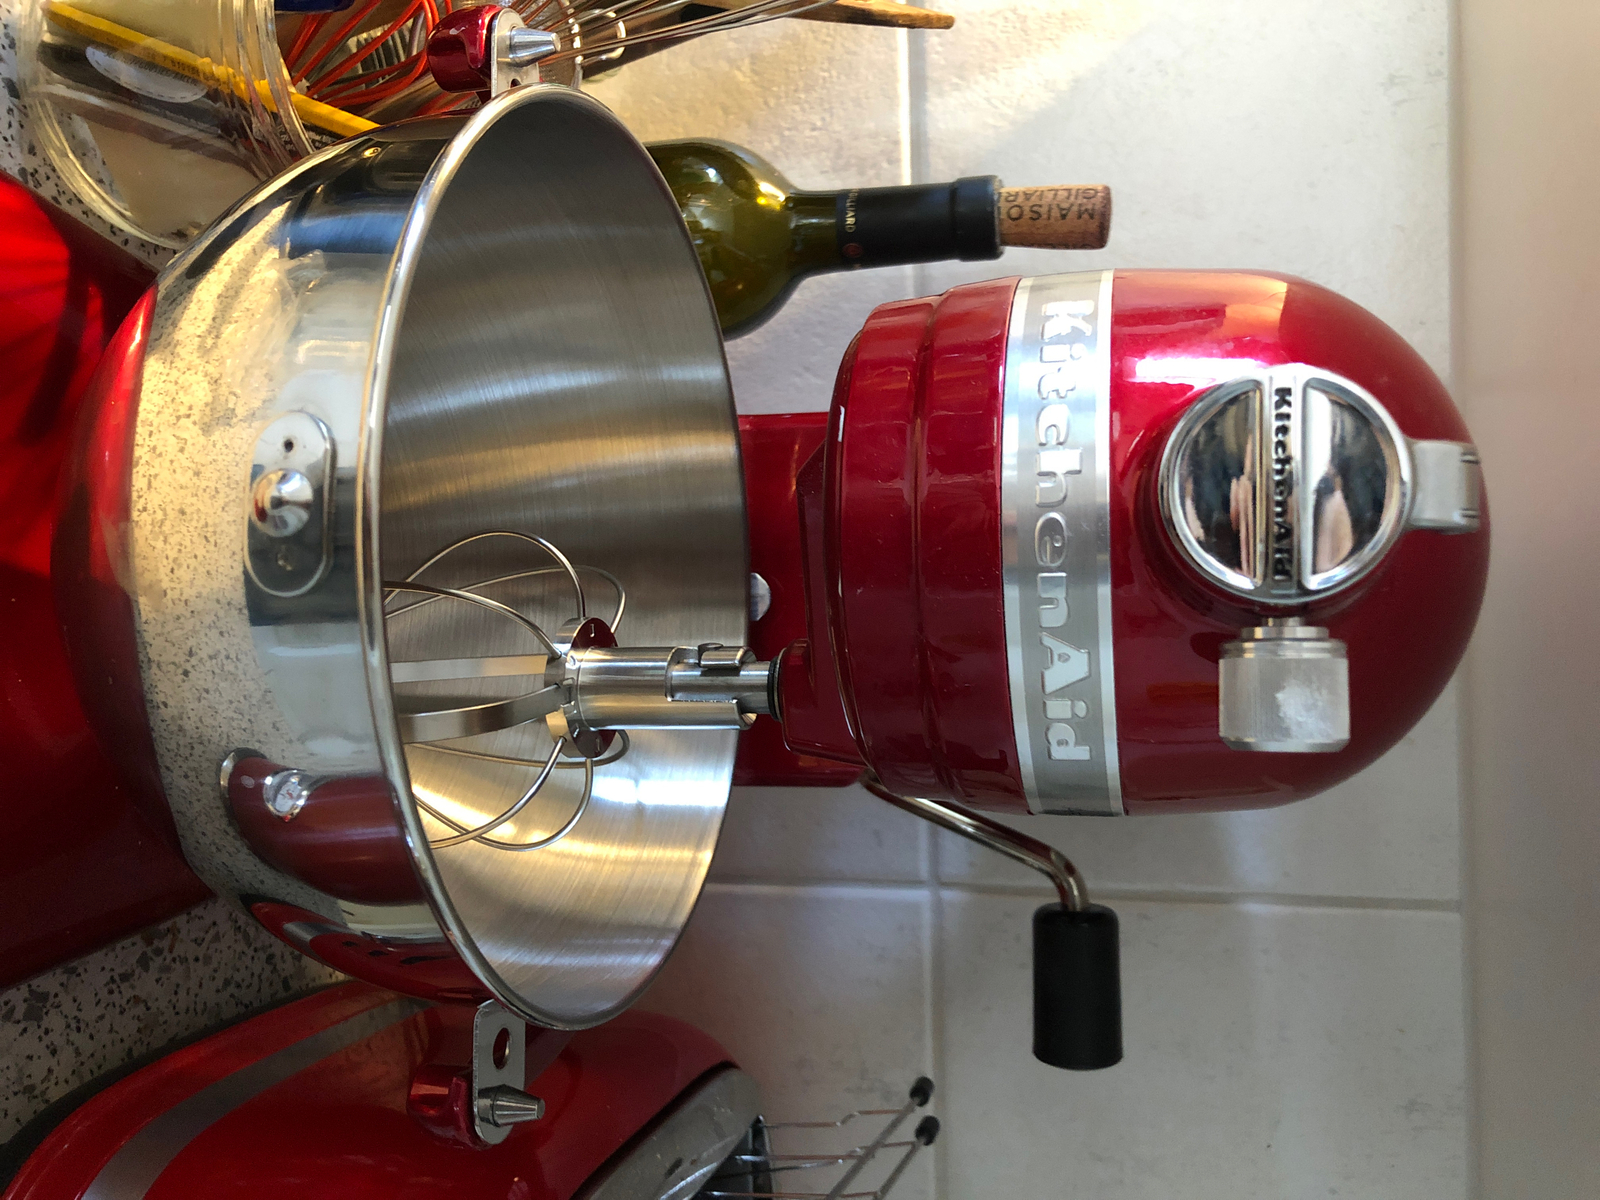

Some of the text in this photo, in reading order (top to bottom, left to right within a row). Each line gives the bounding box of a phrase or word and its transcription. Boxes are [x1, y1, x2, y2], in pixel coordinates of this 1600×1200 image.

[996, 203, 1096, 222] MAISO
[997, 188, 1098, 203] GILLIAR
[1035, 299, 1096, 763] KitchenAid
[1272, 387, 1294, 580] KitchenAid
